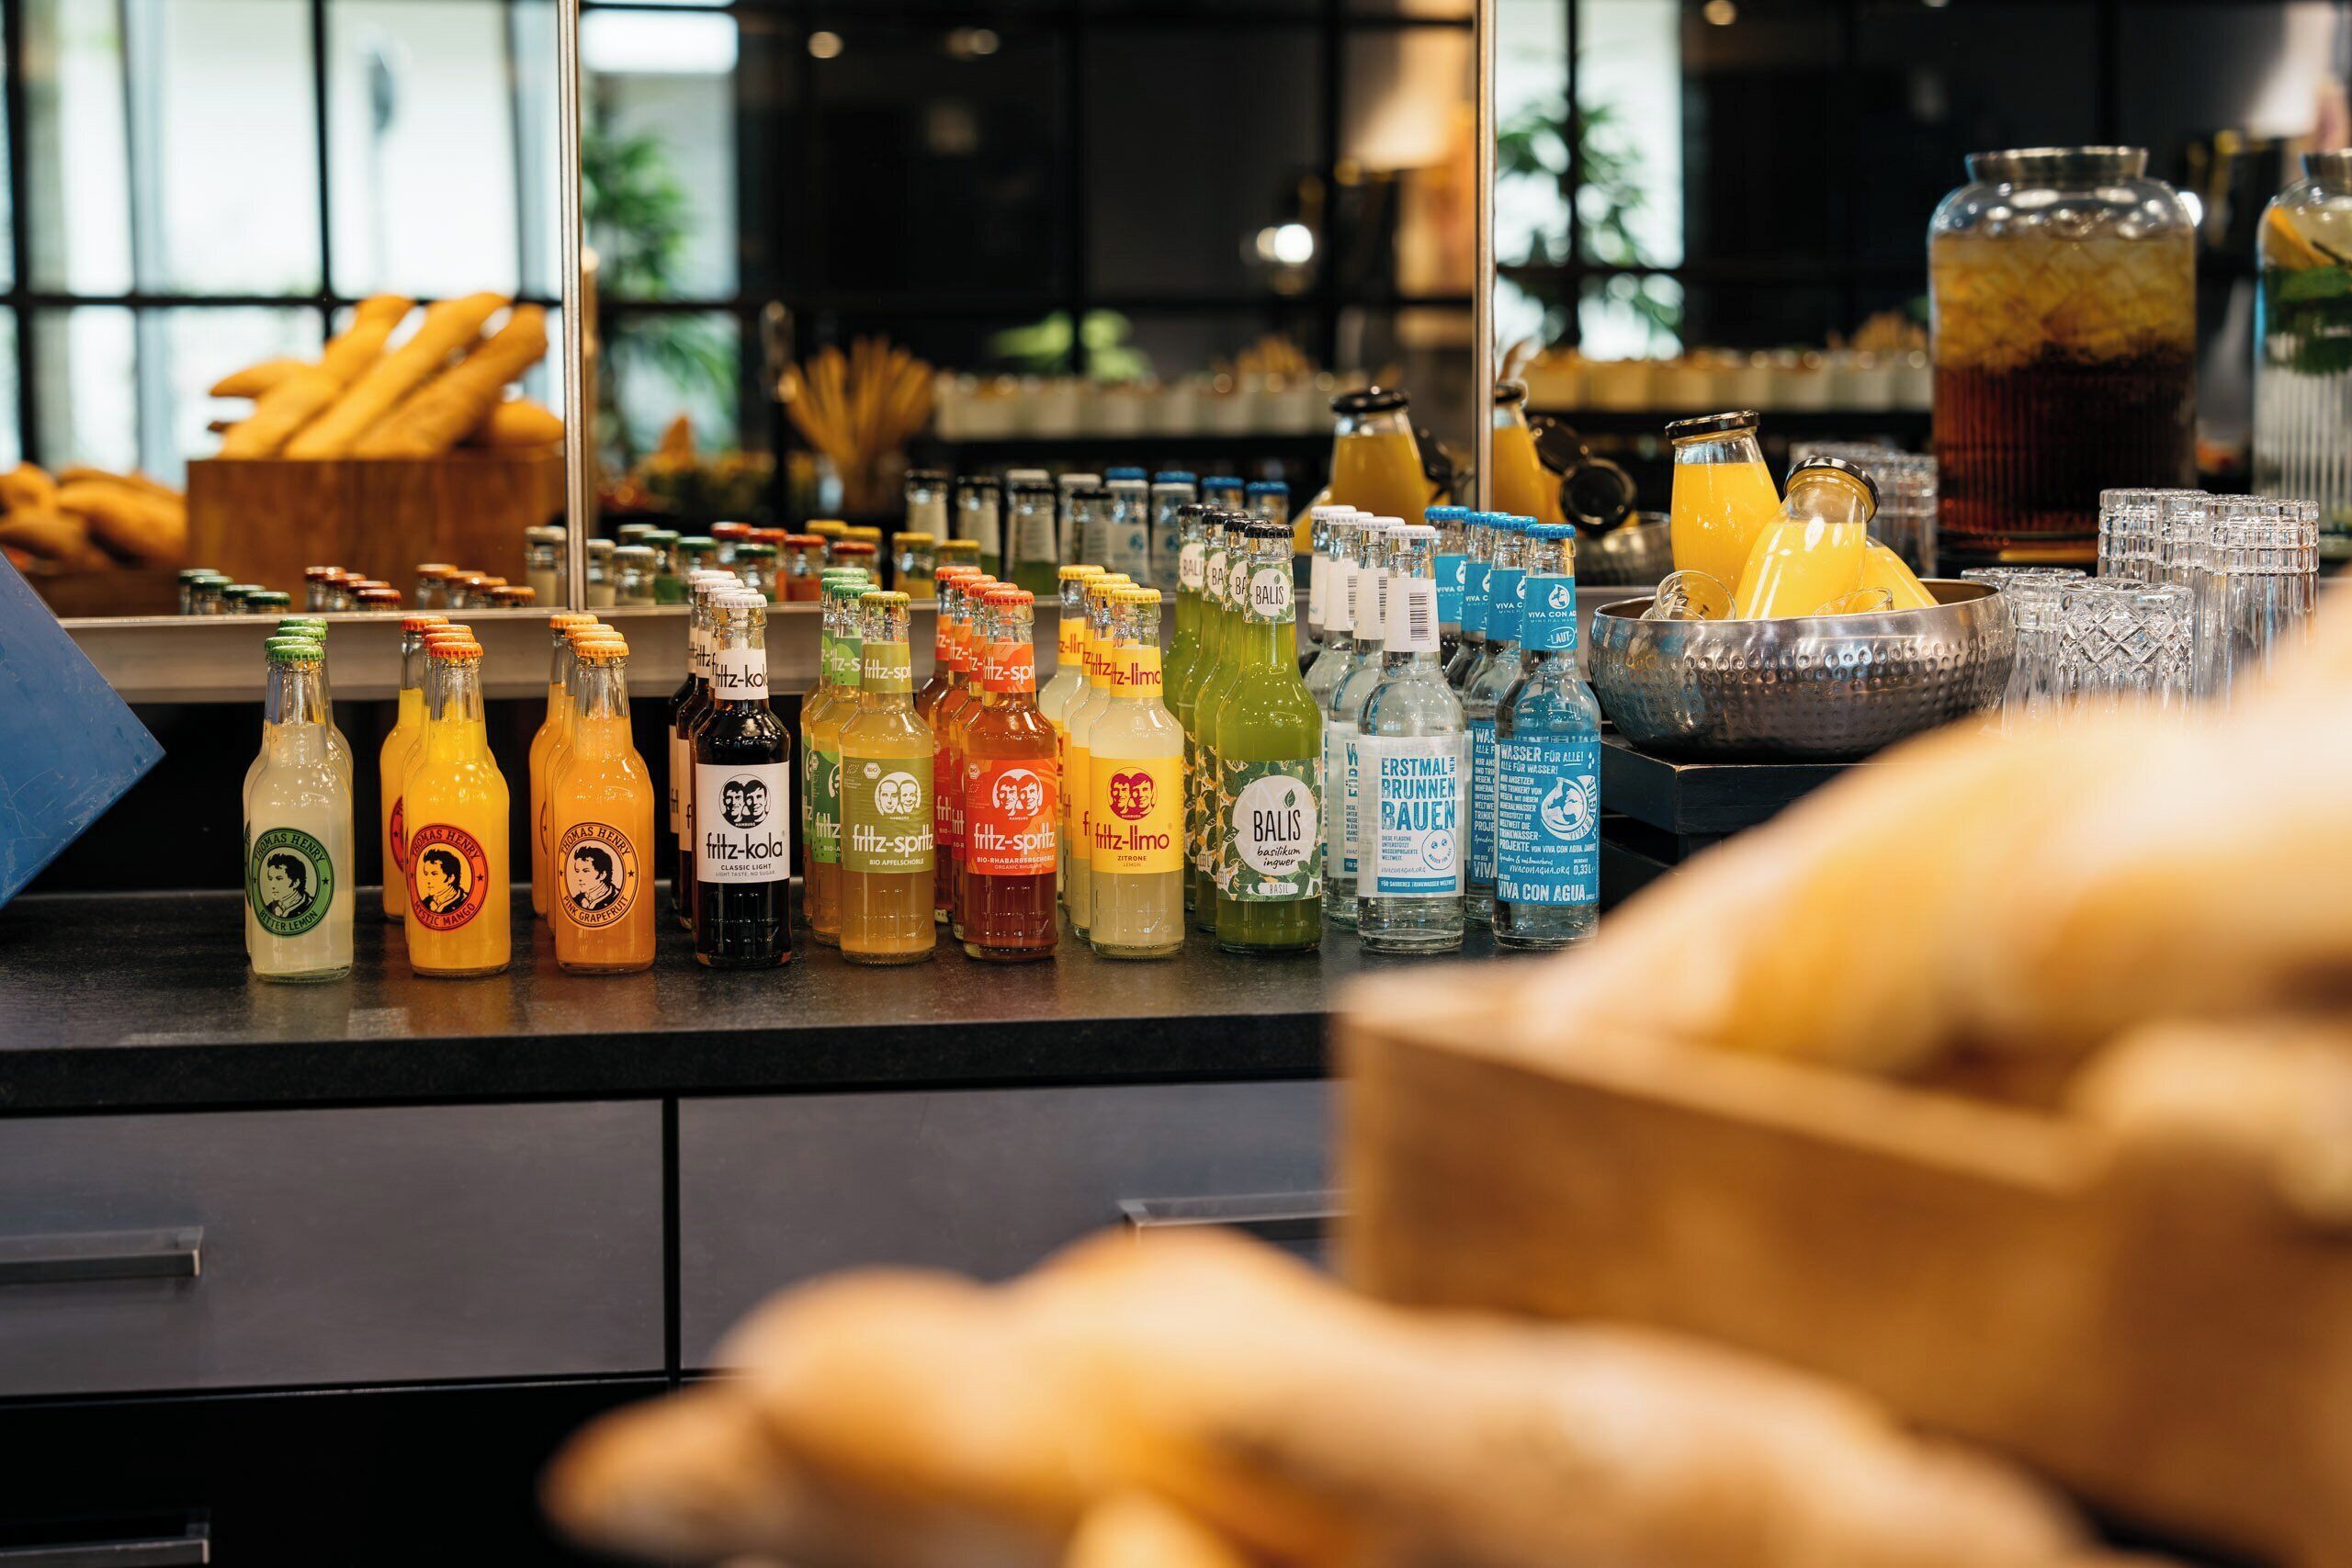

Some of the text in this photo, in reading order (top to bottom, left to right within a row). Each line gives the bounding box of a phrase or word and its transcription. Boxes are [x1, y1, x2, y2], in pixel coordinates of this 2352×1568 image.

[1183, 558, 1203, 577] BALI
[1255, 585, 1284, 605] BALIS
[1499, 743, 1542, 762] WASSER
[1544, 750, 1561, 762] FÜR
[1563, 750, 1584, 762] ALLE!
[1381, 757, 1448, 777] ERSTMAL
[1500, 761, 1558, 775] ALLE FÜR WASSER!
[1381, 777, 1455, 799] BRUNNEN
[1253, 809, 1301, 842] BALIS
[1381, 800, 1455, 831] BAUEN
[254, 833, 326, 863] THOMAS HENRY
[413, 829, 481, 860] THOMAS HENRY
[560, 826, 631, 856] THOMAS HENRY
[706, 832, 783, 860] fritz-kola
[852, 824, 933, 857] fritz-spritz
[974, 823, 1055, 854] fritz-spritz
[1095, 823, 1170, 851] fritz-limo
[1498, 839, 1531, 852] PROJEKTE
[1543, 845, 1555, 853] VIVA
[1556, 845, 1568, 853] CON
[881, 858, 924, 866] APFELSCHORLE
[977, 854, 1055, 864] BIO-RHABARBERSCHORLE
[1257, 845, 1301, 857] basilikum
[1263, 857, 1295, 869] ingwer
[1269, 884, 1289, 895] BASIL
[1498, 880, 1520, 900] VIVA
[1522, 884, 1550, 901] CON
[1553, 884, 1585, 902] AGUA
[259, 909, 319, 931] BITTER LEMON
[413, 900, 476, 926] MYSTIC MANGO
[563, 895, 628, 923] PINK GRAPEFRUIT
